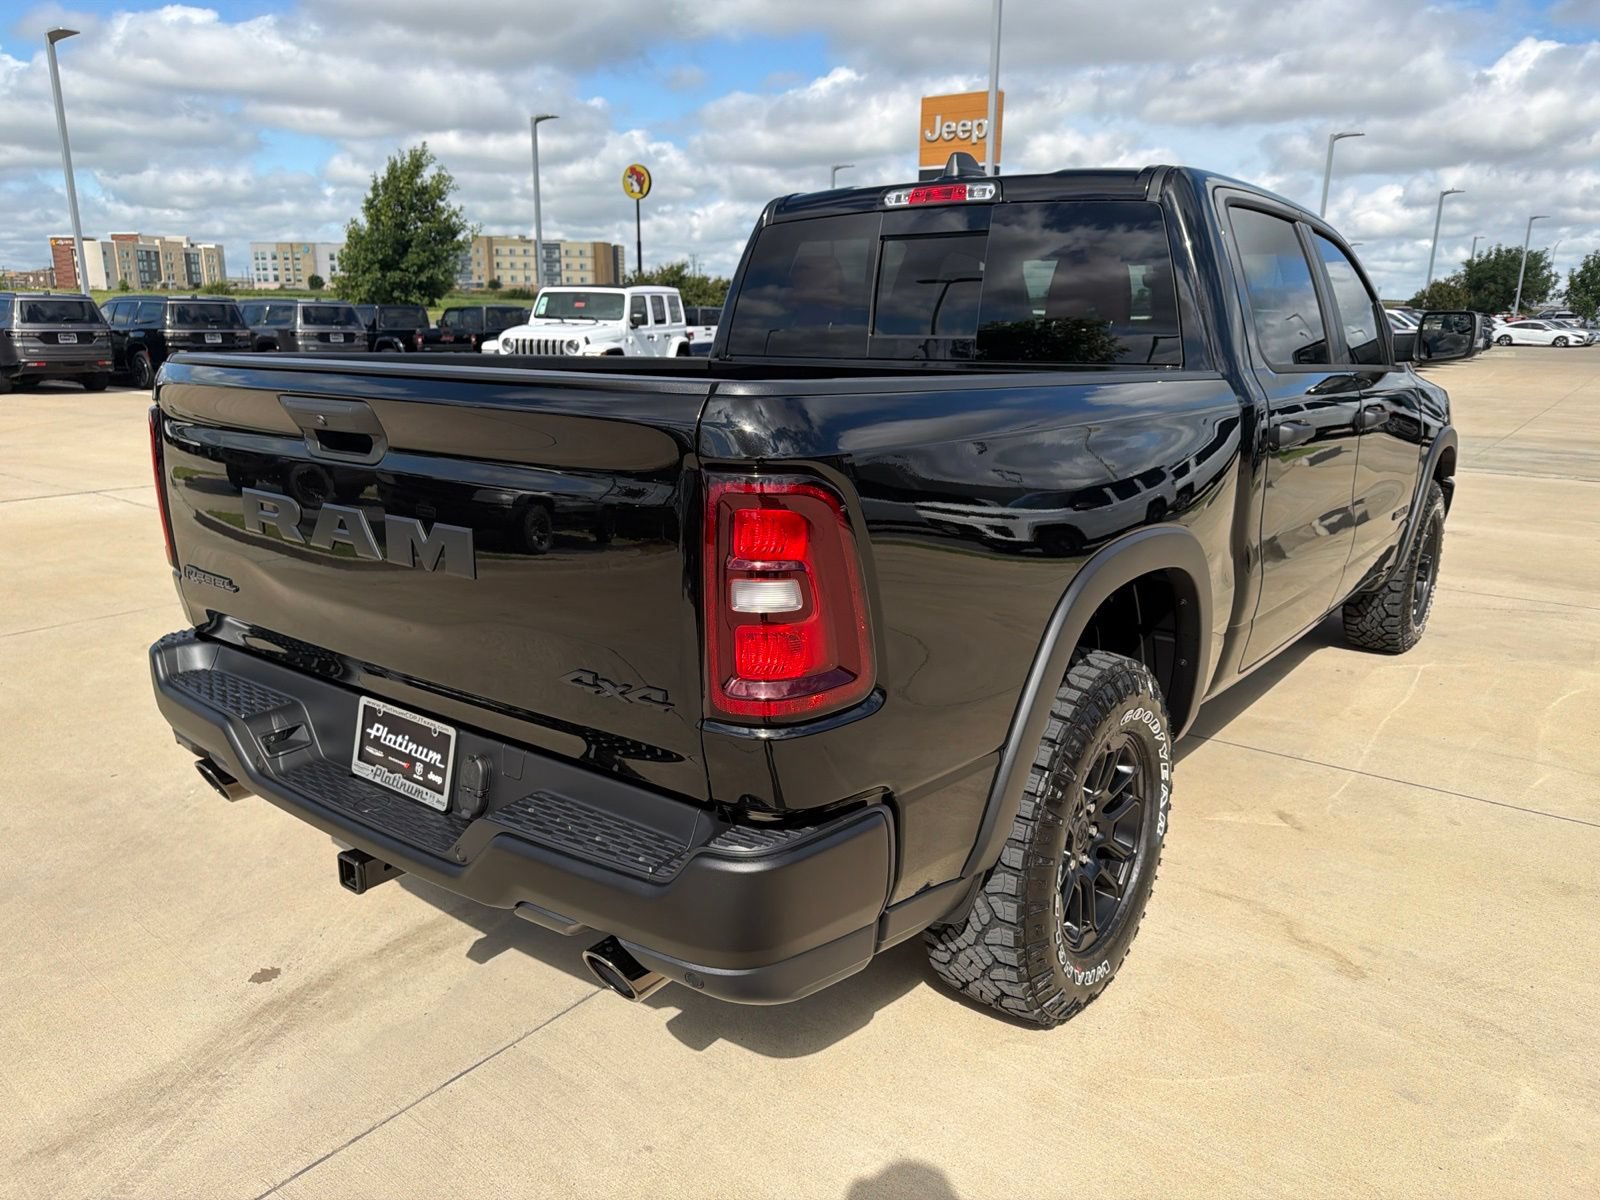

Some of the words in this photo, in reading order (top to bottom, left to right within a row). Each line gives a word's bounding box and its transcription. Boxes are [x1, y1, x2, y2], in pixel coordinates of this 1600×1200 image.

[924, 114, 989, 145] Jeep
[241, 486, 478, 580] RAM
[184, 563, 240, 593] REBEL
[366, 723, 446, 769] Platinum
[371, 766, 428, 802] Platinum
[427, 770, 443, 785] Jeep
[1120, 707, 1169, 837] GOODYEAR
